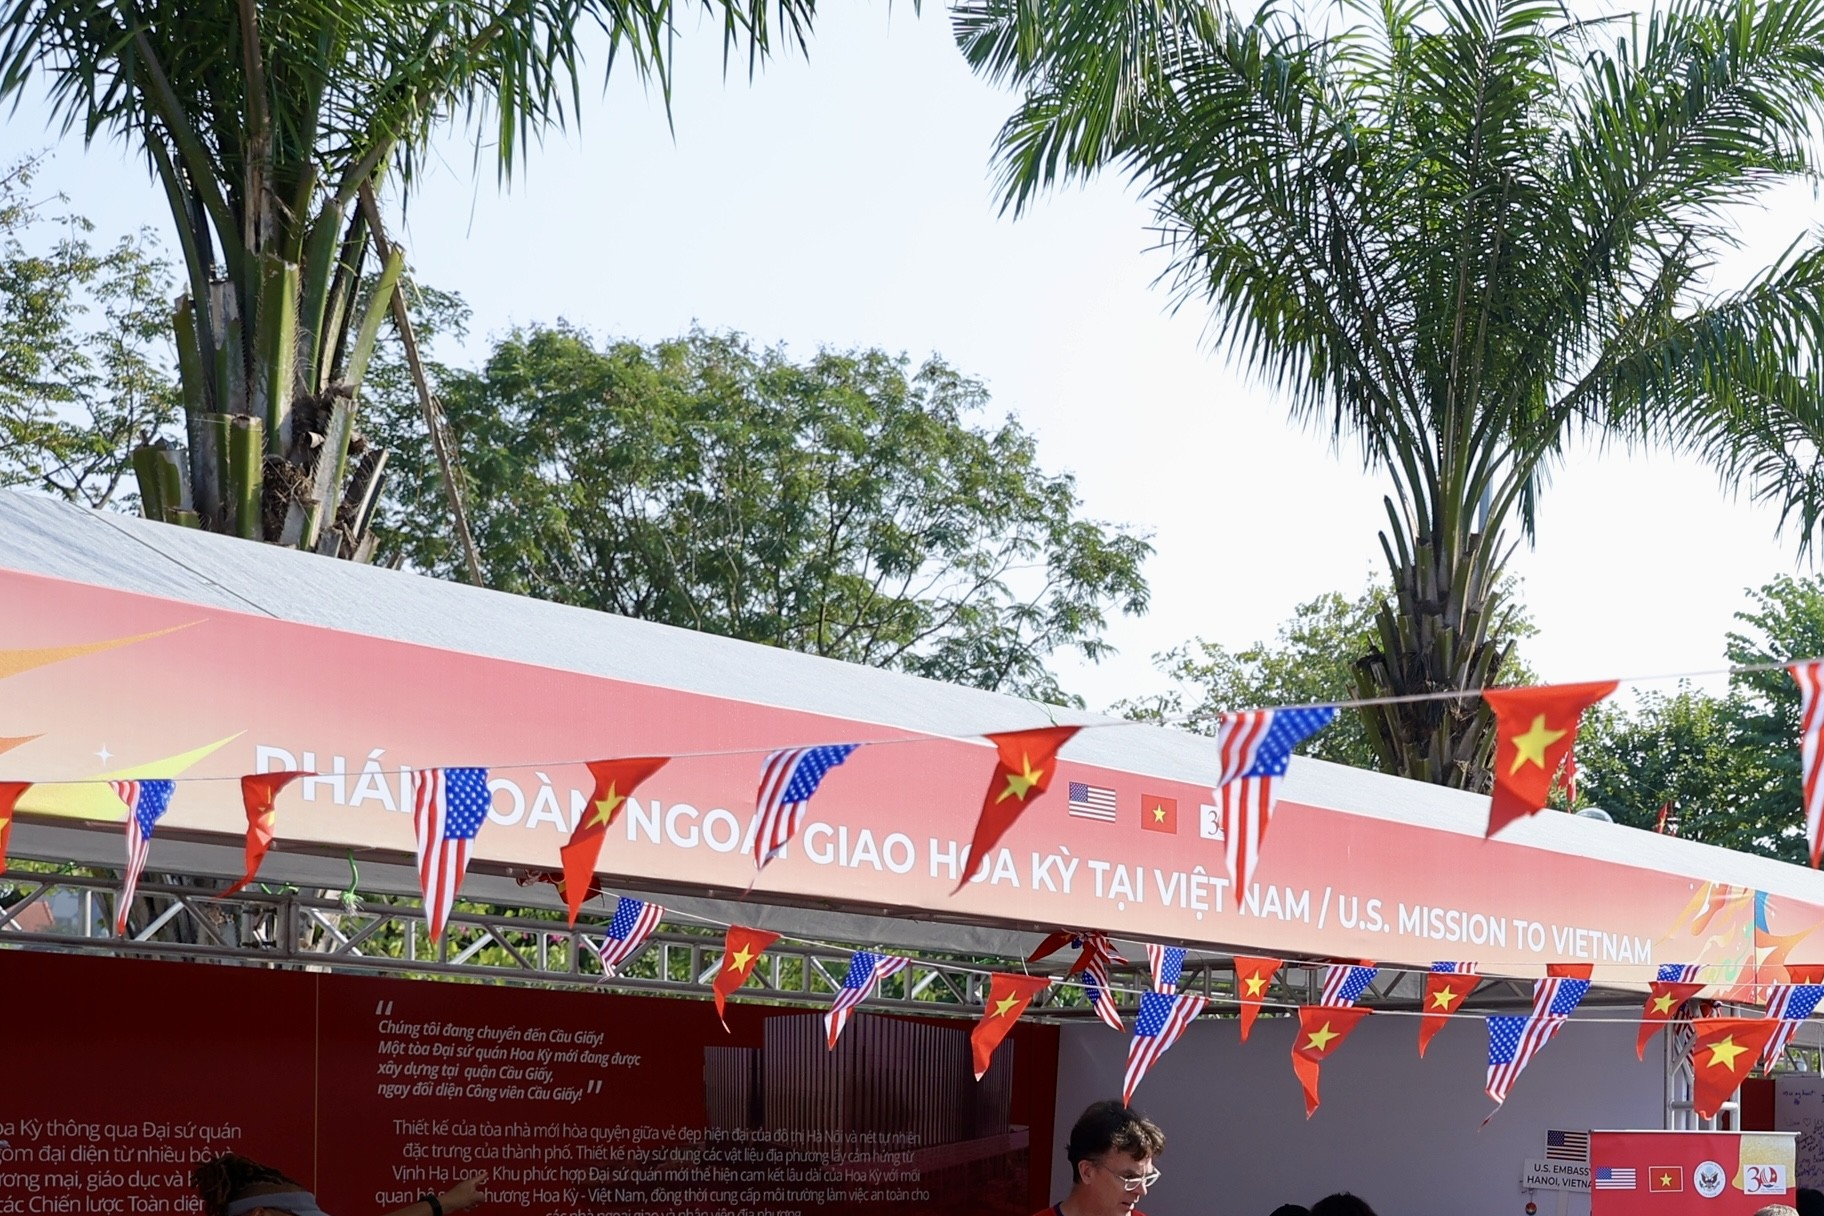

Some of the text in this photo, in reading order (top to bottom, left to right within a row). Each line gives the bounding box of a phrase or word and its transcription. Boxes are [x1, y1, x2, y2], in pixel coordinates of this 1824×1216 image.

[804, 822, 916, 875] GIAO
[1032, 845, 1081, 894] KỲ
[1088, 862, 1143, 910] TẠI
[1155, 862, 1230, 919] VIỆT
[1245, 887, 1311, 929] NAM
[1317, 887, 1331, 929] /
[1338, 895, 1389, 934] U.S.
[1399, 903, 1506, 948] MISSION
[1512, 918, 1547, 953] TO
[1551, 927, 1652, 966] VIETNAM
[379, 1019, 605, 1046] Chúng tôi đang chuyển đến Cầu Giấy!
[378, 1041, 641, 1069] Một tòa Đại sứ quán Hoa Kỳ mới đang được
[377, 1061, 401, 1076] xây
[404, 1061, 439, 1080] dựng
[442, 1063, 459, 1077] tại
[464, 1065, 497, 1081] quận
[499, 1064, 523, 1080] Cầu
[377, 1081, 582, 1104] ngay đối diện Công viên Cầu Giấy!
[20, 1118, 43, 1144] Kỳ
[46, 1119, 100, 1141] thông
[104, 1123, 138, 1141] qua
[142, 1121, 170, 1142] Đại
[174, 1121, 198, 1138] sứ
[199, 1123, 241, 1143] quán
[38, 1145, 185, 1164] đại diện từ nhiều
[89, 1171, 124, 1192] giáo
[128, 1170, 160, 1192] dục
[163, 1172, 184, 1188] và
[1534, 1164, 1591, 1176] U.S. EMBASS
[1527, 1176, 1560, 1187] HANOI,
[29, 1195, 170, 1215] Chiến lược Toàn
